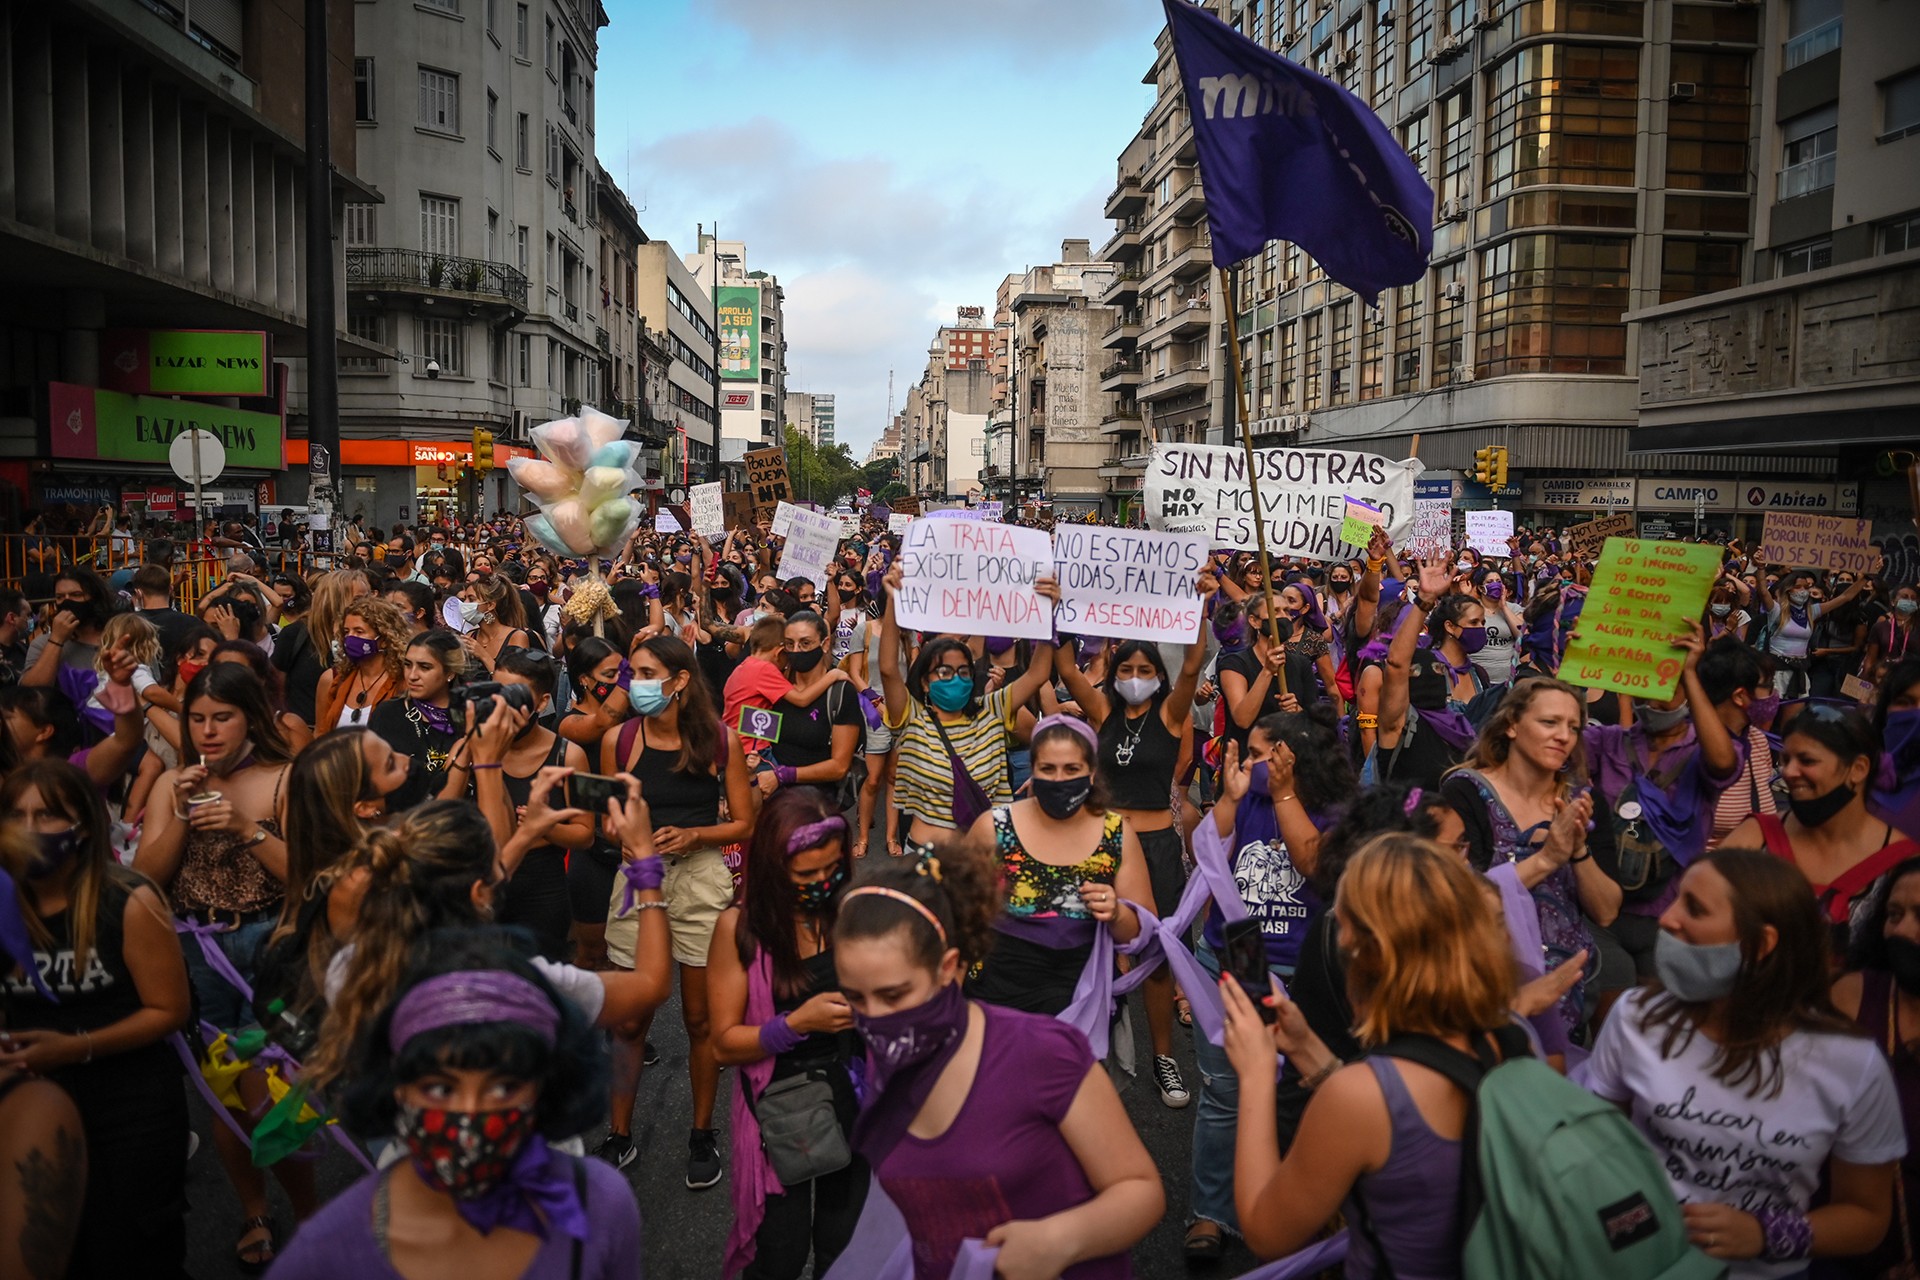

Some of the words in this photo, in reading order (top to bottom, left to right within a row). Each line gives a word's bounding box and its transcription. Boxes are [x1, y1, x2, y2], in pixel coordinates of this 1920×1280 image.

[718, 306, 753, 316] ARROLLA
[733, 316, 753, 326] SED
[155, 356, 208, 369] BAZAR
[216, 357, 259, 370] NEWS
[1054, 404, 1068, 414] por
[1069, 404, 1078, 413] su
[1052, 415, 1079, 426] dinero
[746, 456, 766, 470] POR
[765, 455, 782, 467] LAS
[1160, 450, 1213, 480] SIN
[1224, 449, 1386, 485] NOSOTRAS
[749, 470, 773, 484] QUE
[1542, 480, 1585, 490] CAMBIO
[1587, 481, 1631, 489] CAMBILEX
[43, 487, 111, 499] TRAMONTINA
[151, 491, 175, 504] Cuori
[1163, 488, 1196, 502] NO
[1544, 492, 1580, 504] PEREZ
[1769, 490, 1827, 508] Abitab
[1162, 502, 1204, 517] HAY
[1414, 501, 1425, 511] LA
[1571, 524, 1592, 540] HOY
[1595, 515, 1628, 533] ESTOY
[1767, 513, 1813, 529] MARCHO
[1817, 518, 1842, 532] HOY
[908, 523, 938, 550] LA
[949, 523, 1016, 555] TRATA
[1764, 527, 1810, 544] PORQUE
[1814, 531, 1868, 551] MAÑANA
[1055, 532, 1083, 559] NO
[1089, 534, 1199, 571] ESTAMOS
[1624, 541, 1640, 554] YO
[1654, 546, 1687, 557] TODO
[1617, 556, 1633, 566] LO
[1762, 544, 1784, 563] NO
[1786, 547, 1805, 564] SE
[1808, 549, 1823, 566] SI
[1829, 551, 1876, 573] ESTOY
[977, 555, 1043, 586] PORQUE
[1614, 572, 1627, 582] YO
[1635, 575, 1666, 587] TODO
[1609, 586, 1622, 596] LO
[1627, 590, 1671, 604] ROMPO
[900, 583, 932, 614] HAY
[942, 587, 1042, 624] DEMANDA
[1056, 599, 1077, 622] AS
[1084, 602, 1197, 631] ASESINADAS
[1588, 644, 1599, 656] TE
[1607, 646, 1653, 663] APAGA
[1612, 671, 1650, 688] OJOS
[1271, 905, 1307, 918] PASO
[1654, 1086, 1767, 1149] educar
[1772, 1130, 1812, 1150] en
